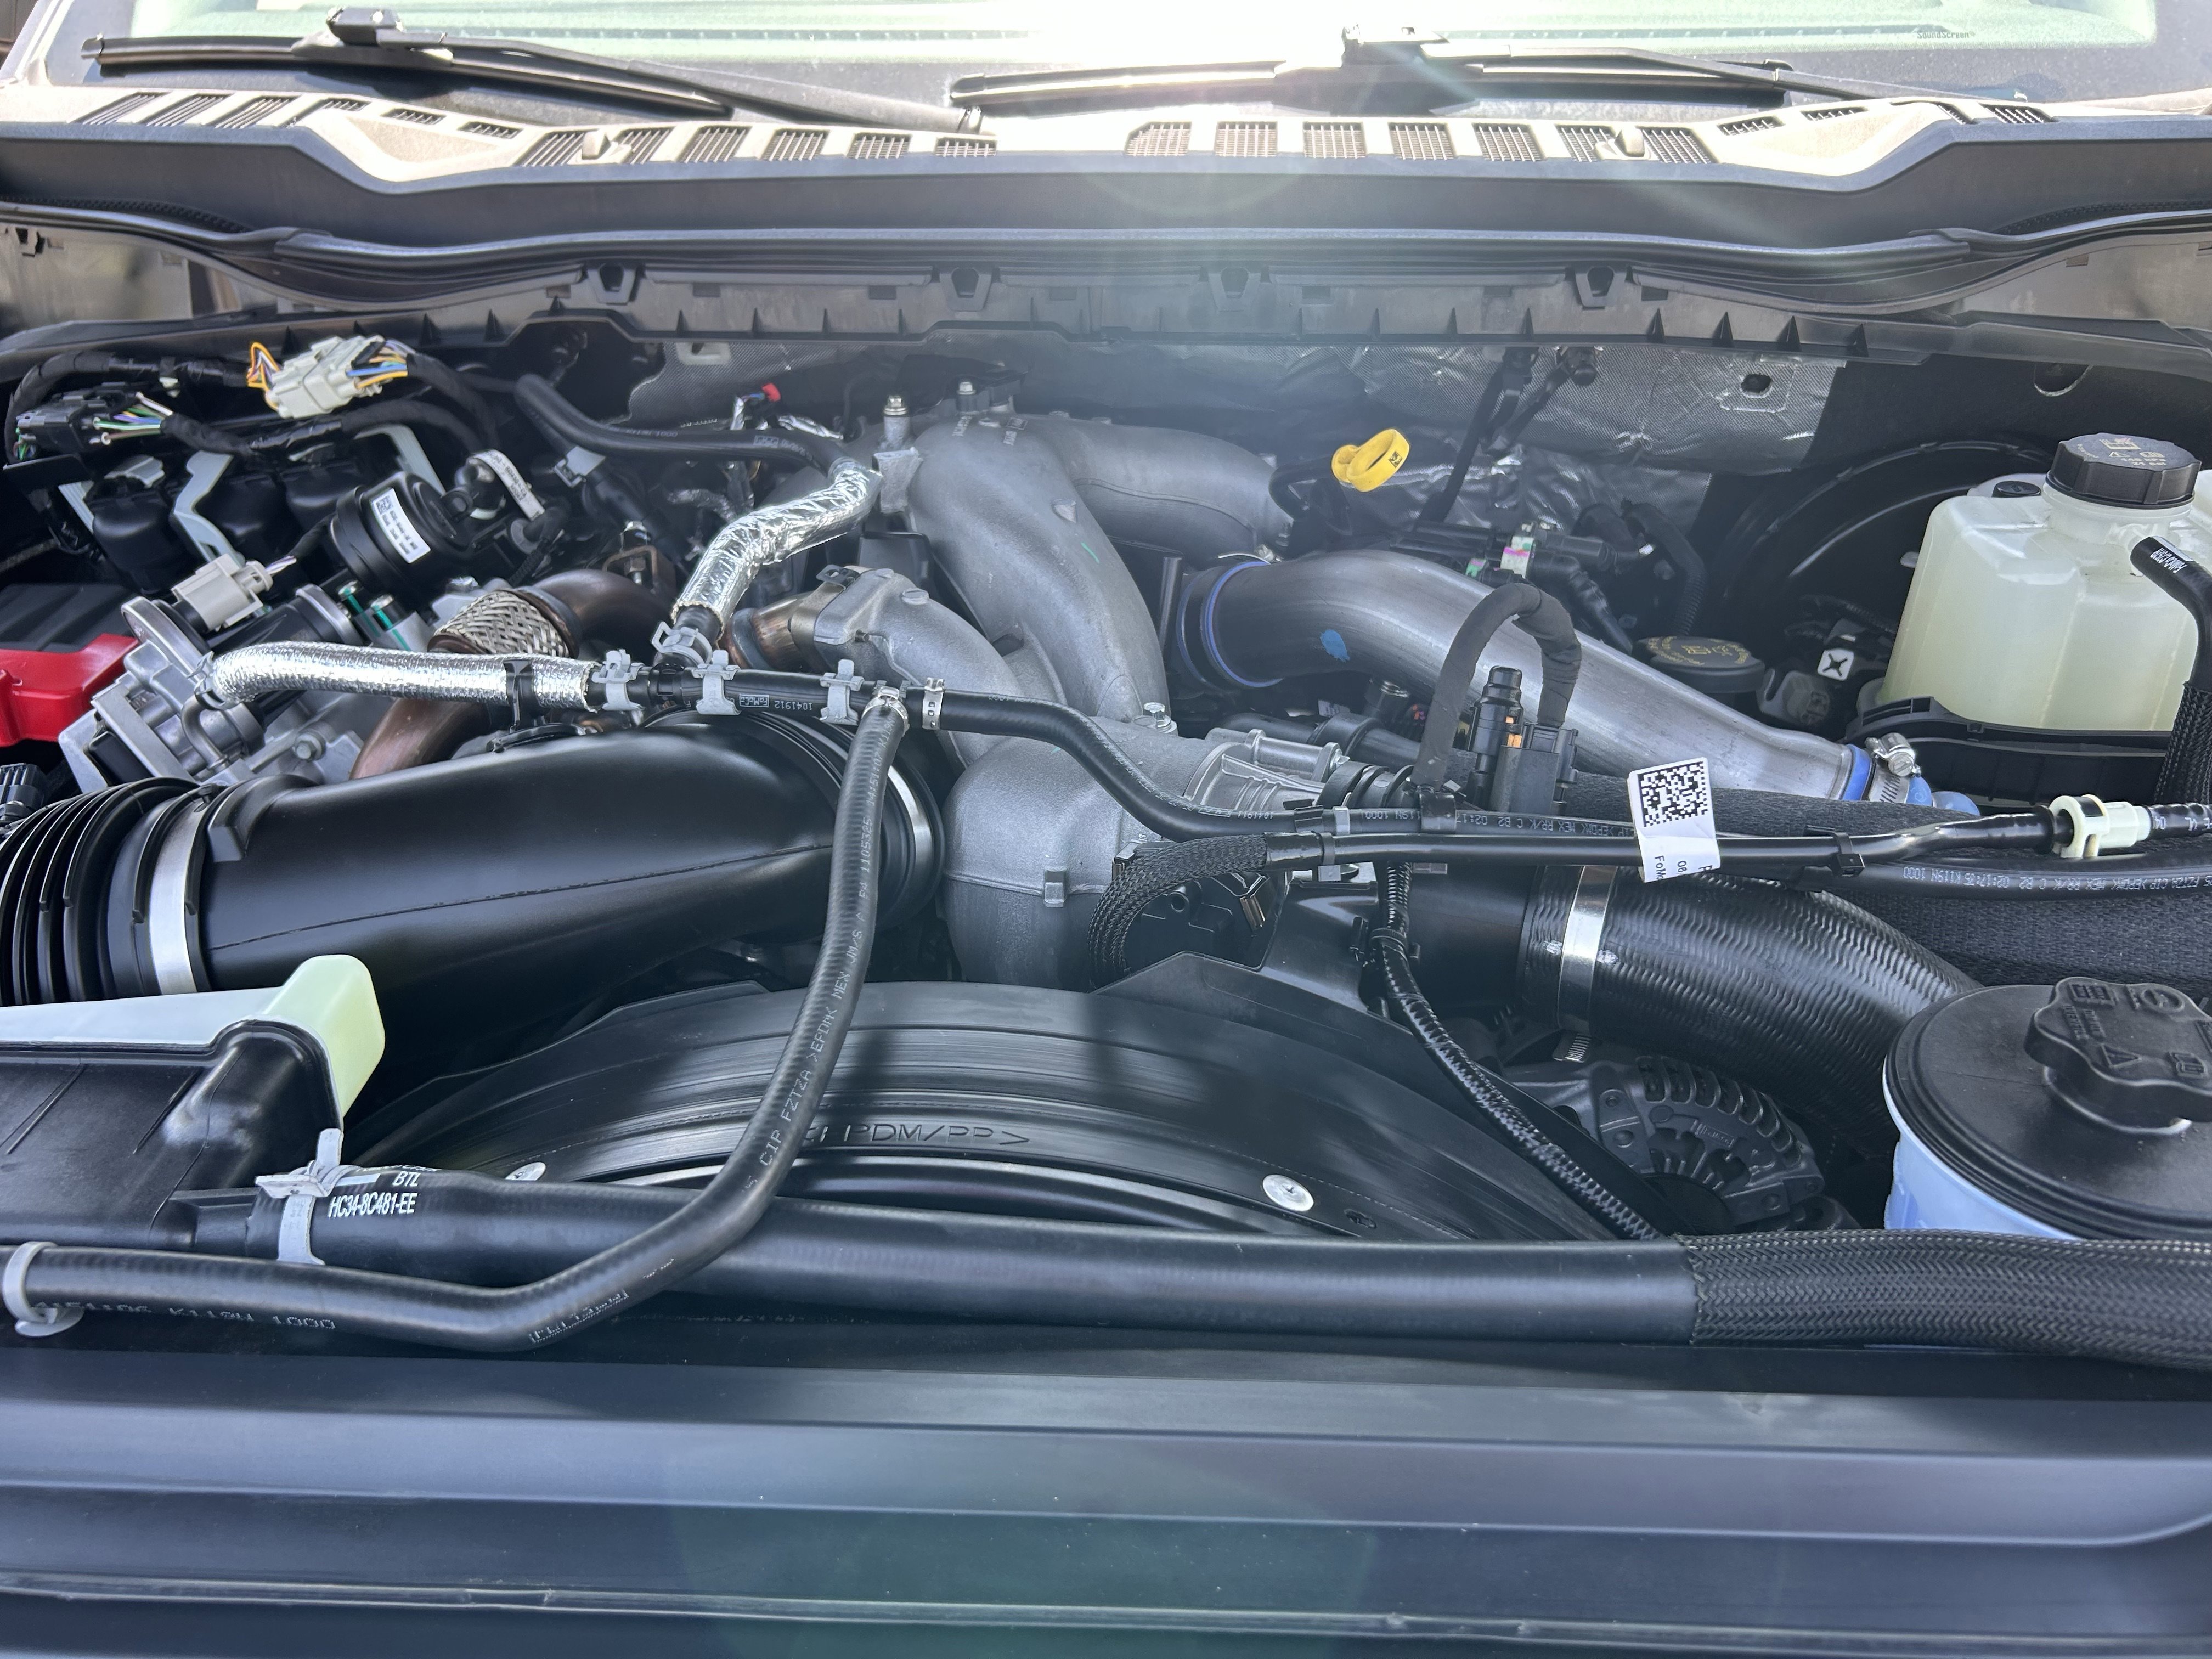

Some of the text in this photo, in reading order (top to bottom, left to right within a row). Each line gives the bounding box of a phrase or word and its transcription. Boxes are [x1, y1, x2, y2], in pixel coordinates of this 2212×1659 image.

[740, 696, 813, 711] 1041912 FoMoCo
[1365, 810, 1388, 820] 1000
[1516, 817, 1523, 829] C
[1903, 866, 1926, 881] 1000
[759, 1128, 781, 1166] CIP
[831, 971, 851, 1000] MEX
[392, 1170, 421, 1187] BTL
[327, 1191, 418, 1218] HC34-8C481-EE
